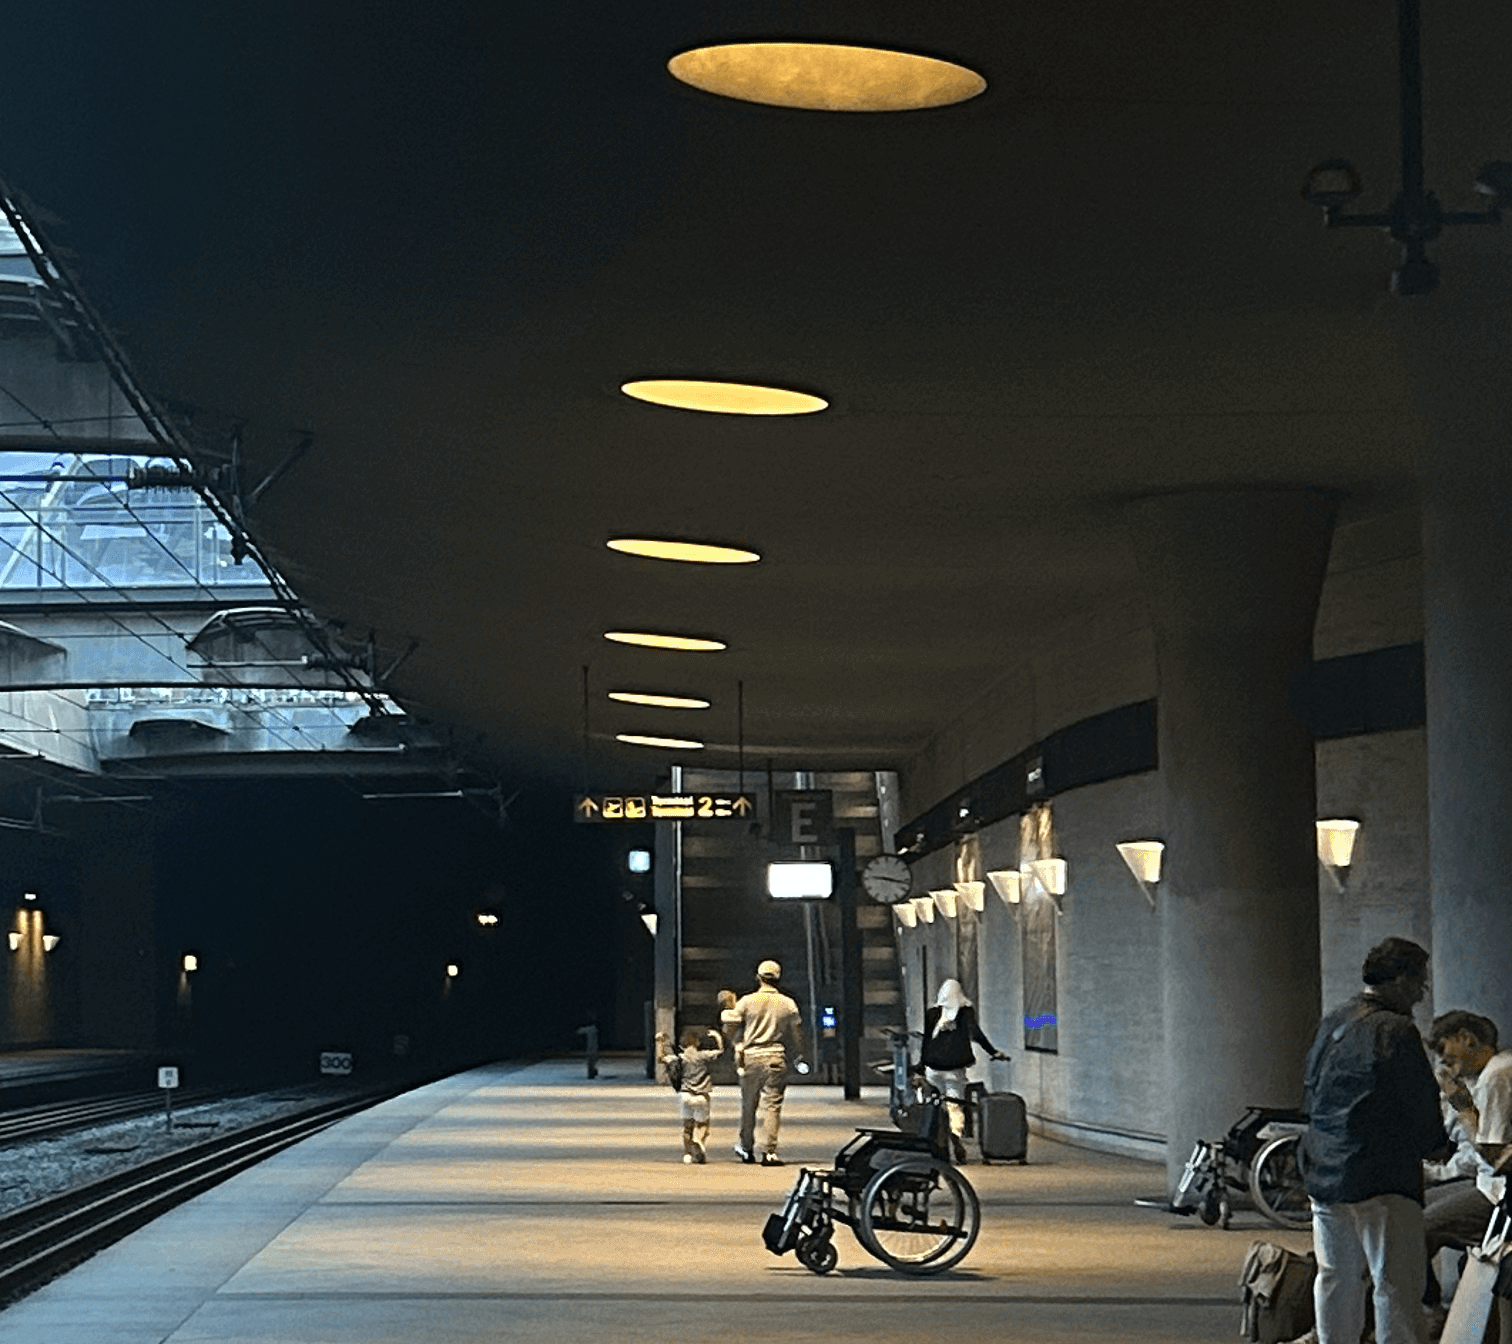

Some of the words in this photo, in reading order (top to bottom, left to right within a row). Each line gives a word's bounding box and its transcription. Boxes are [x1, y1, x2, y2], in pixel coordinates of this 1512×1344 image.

[697, 796, 714, 817] 2
[791, 802, 819, 843] E
[320, 1055, 352, 1070] 300
